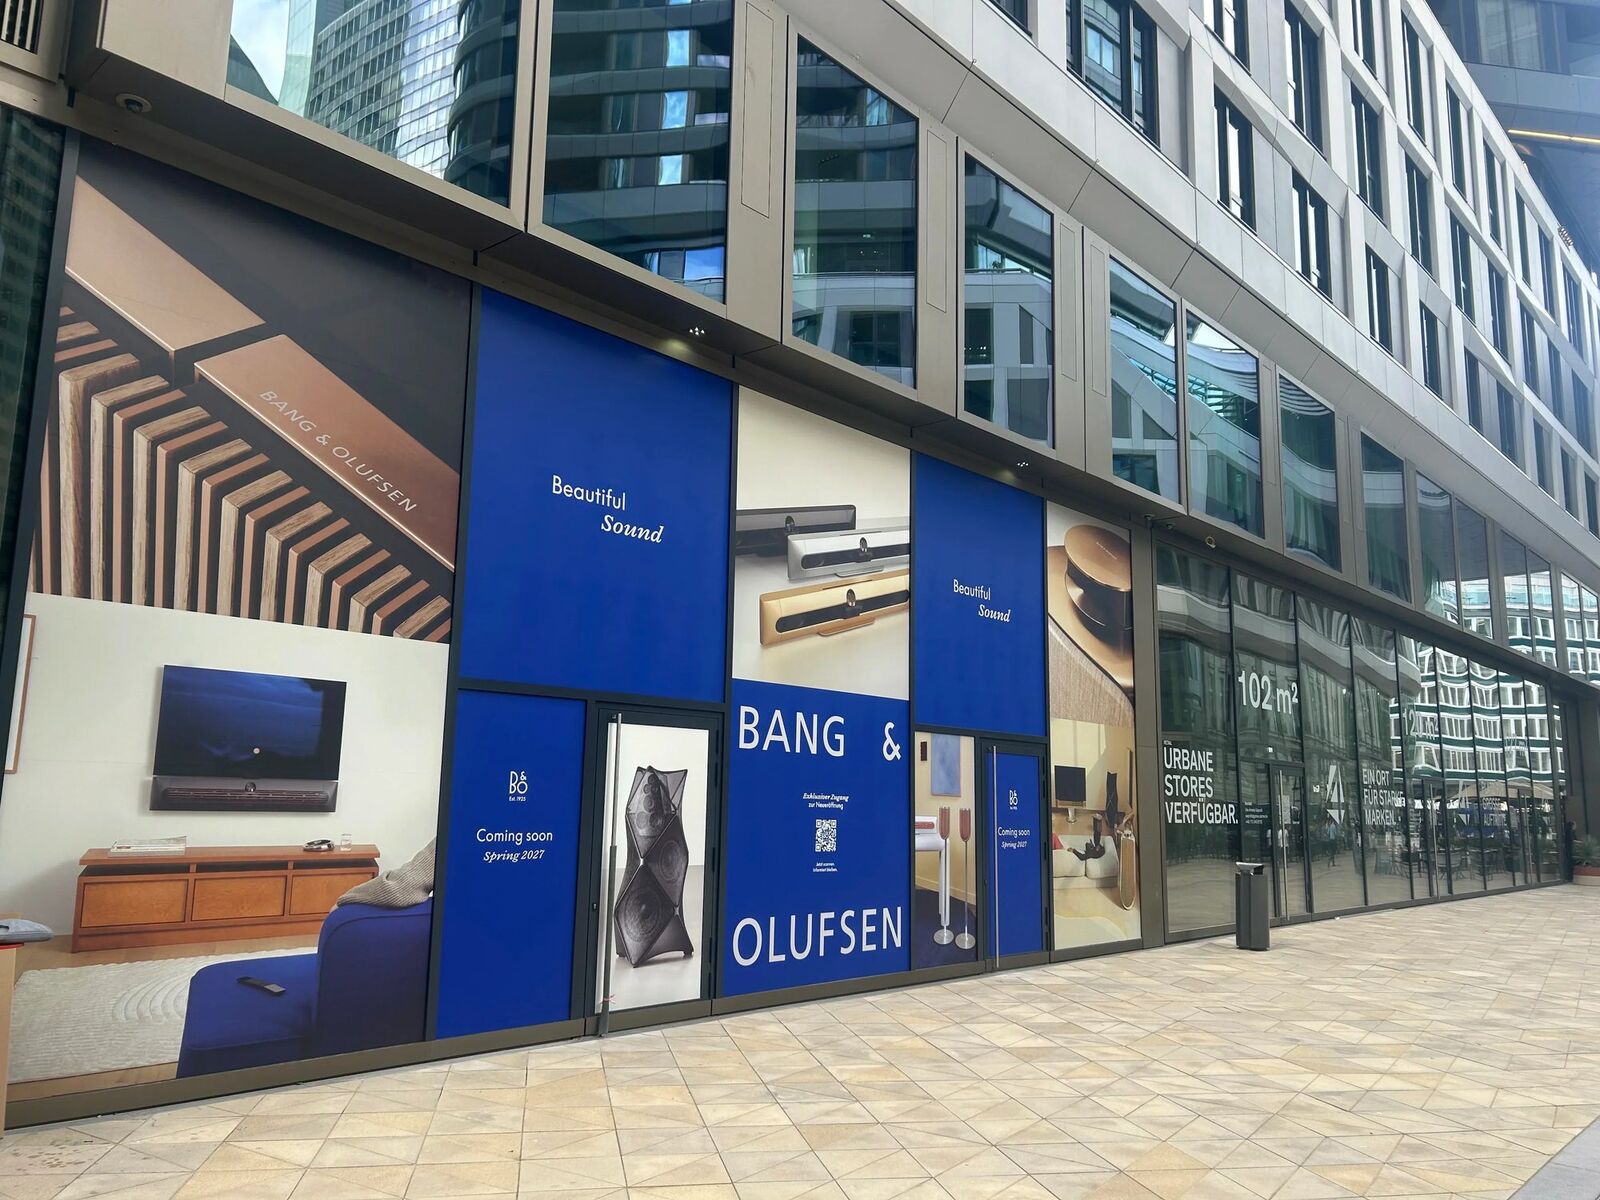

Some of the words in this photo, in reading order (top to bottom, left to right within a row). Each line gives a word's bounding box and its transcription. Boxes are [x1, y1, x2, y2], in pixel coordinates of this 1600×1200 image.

[260, 391, 317, 432] BANG
[316, 434, 331, 446] &
[332, 446, 417, 512] OLUFSEN
[552, 474, 626, 511] Beautiful
[601, 514, 664, 543] Sound
[953, 578, 991, 601] Beautiful
[978, 604, 1011, 622] Sound
[1238, 670, 1273, 711] 102
[738, 705, 846, 758] BANG
[882, 721, 902, 762] &
[1163, 746, 1214, 772] URBANE
[1164, 774, 1214, 798] STORES
[1362, 768, 1376, 785] EIN
[1376, 769, 1390, 786] ORT
[1164, 798, 1239, 824] VERFÜGBAR.
[476, 828, 523, 846] Coming
[526, 832, 553, 842] soon
[997, 826, 1018, 839] Coming
[483, 850, 520, 864] Spring
[520, 849, 546, 860] 2027
[1001, 841, 1017, 850] Spring
[732, 906, 902, 967] OLUFSEN
